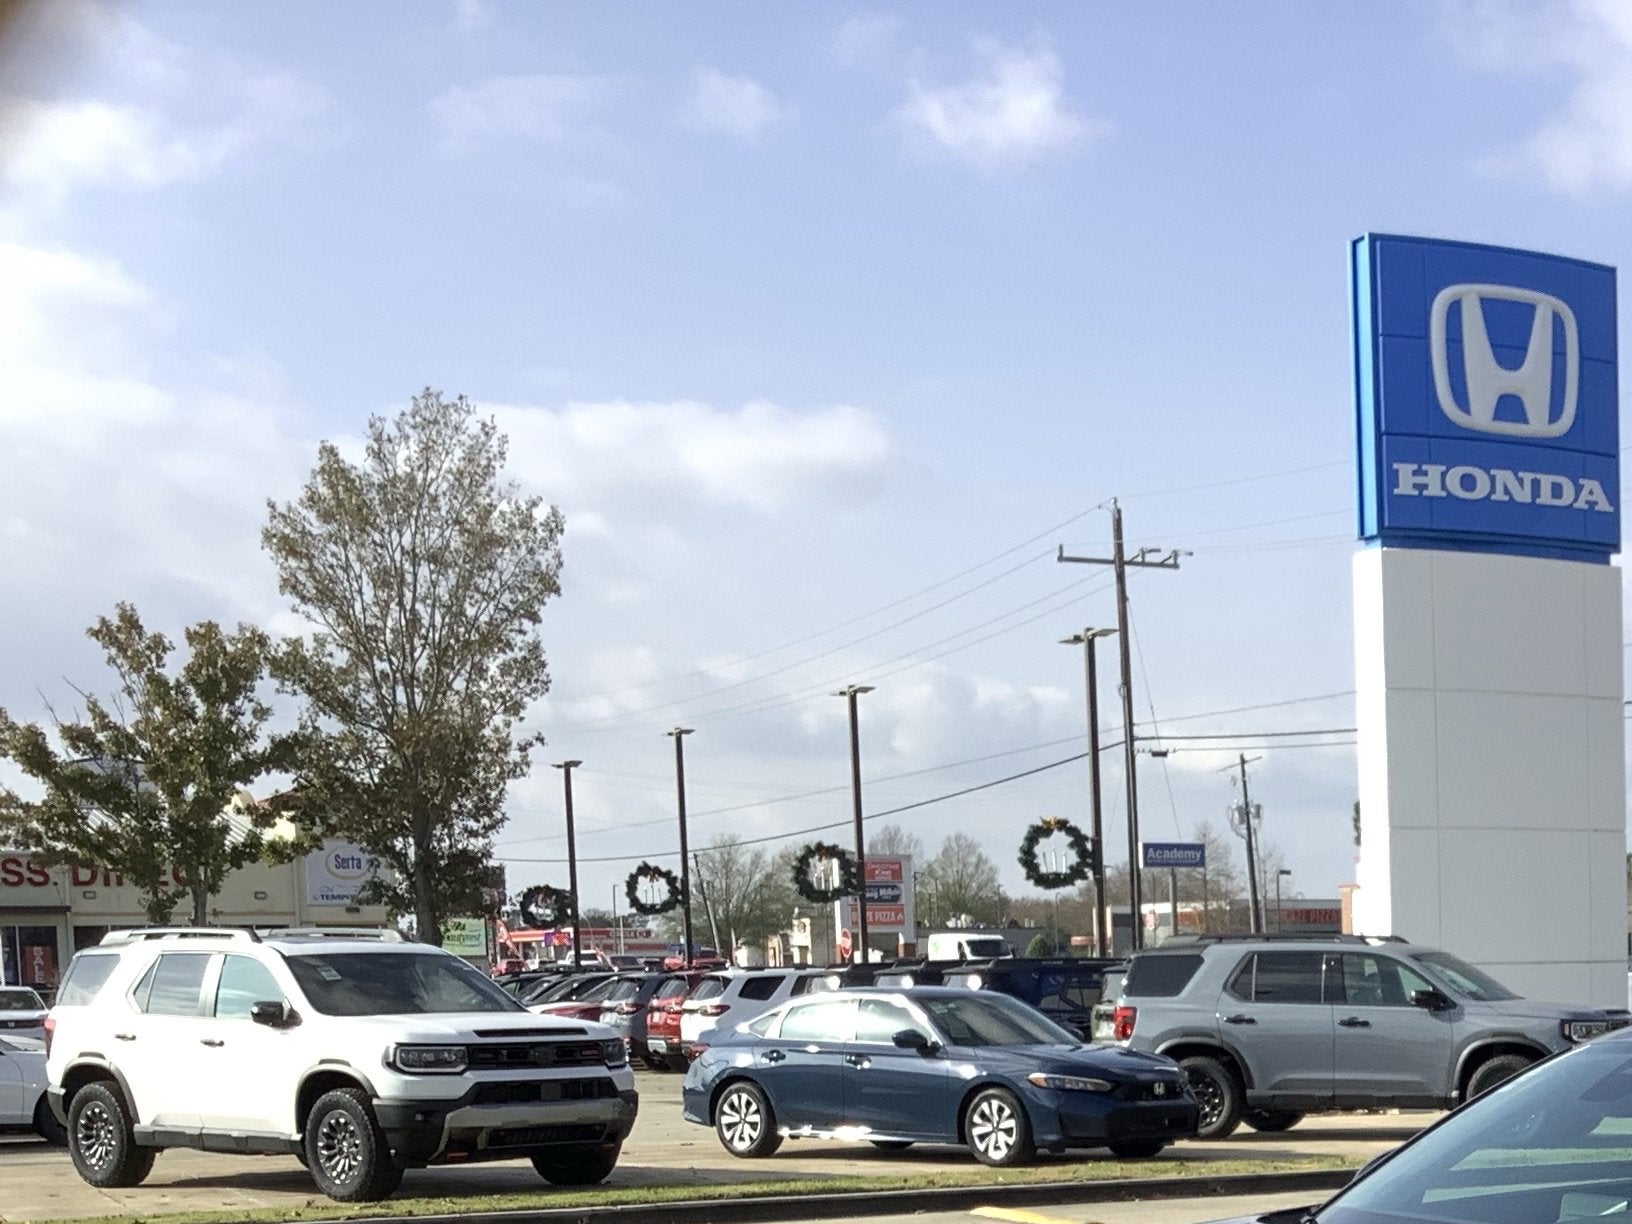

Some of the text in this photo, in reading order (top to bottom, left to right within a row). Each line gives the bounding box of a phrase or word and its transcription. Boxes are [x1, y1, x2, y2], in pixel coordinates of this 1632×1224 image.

[1392, 463, 1614, 512] HONDA
[334, 854, 362, 870] Serta
[1147, 847, 1201, 862] Academy
[33, 946, 45, 984] SALE
